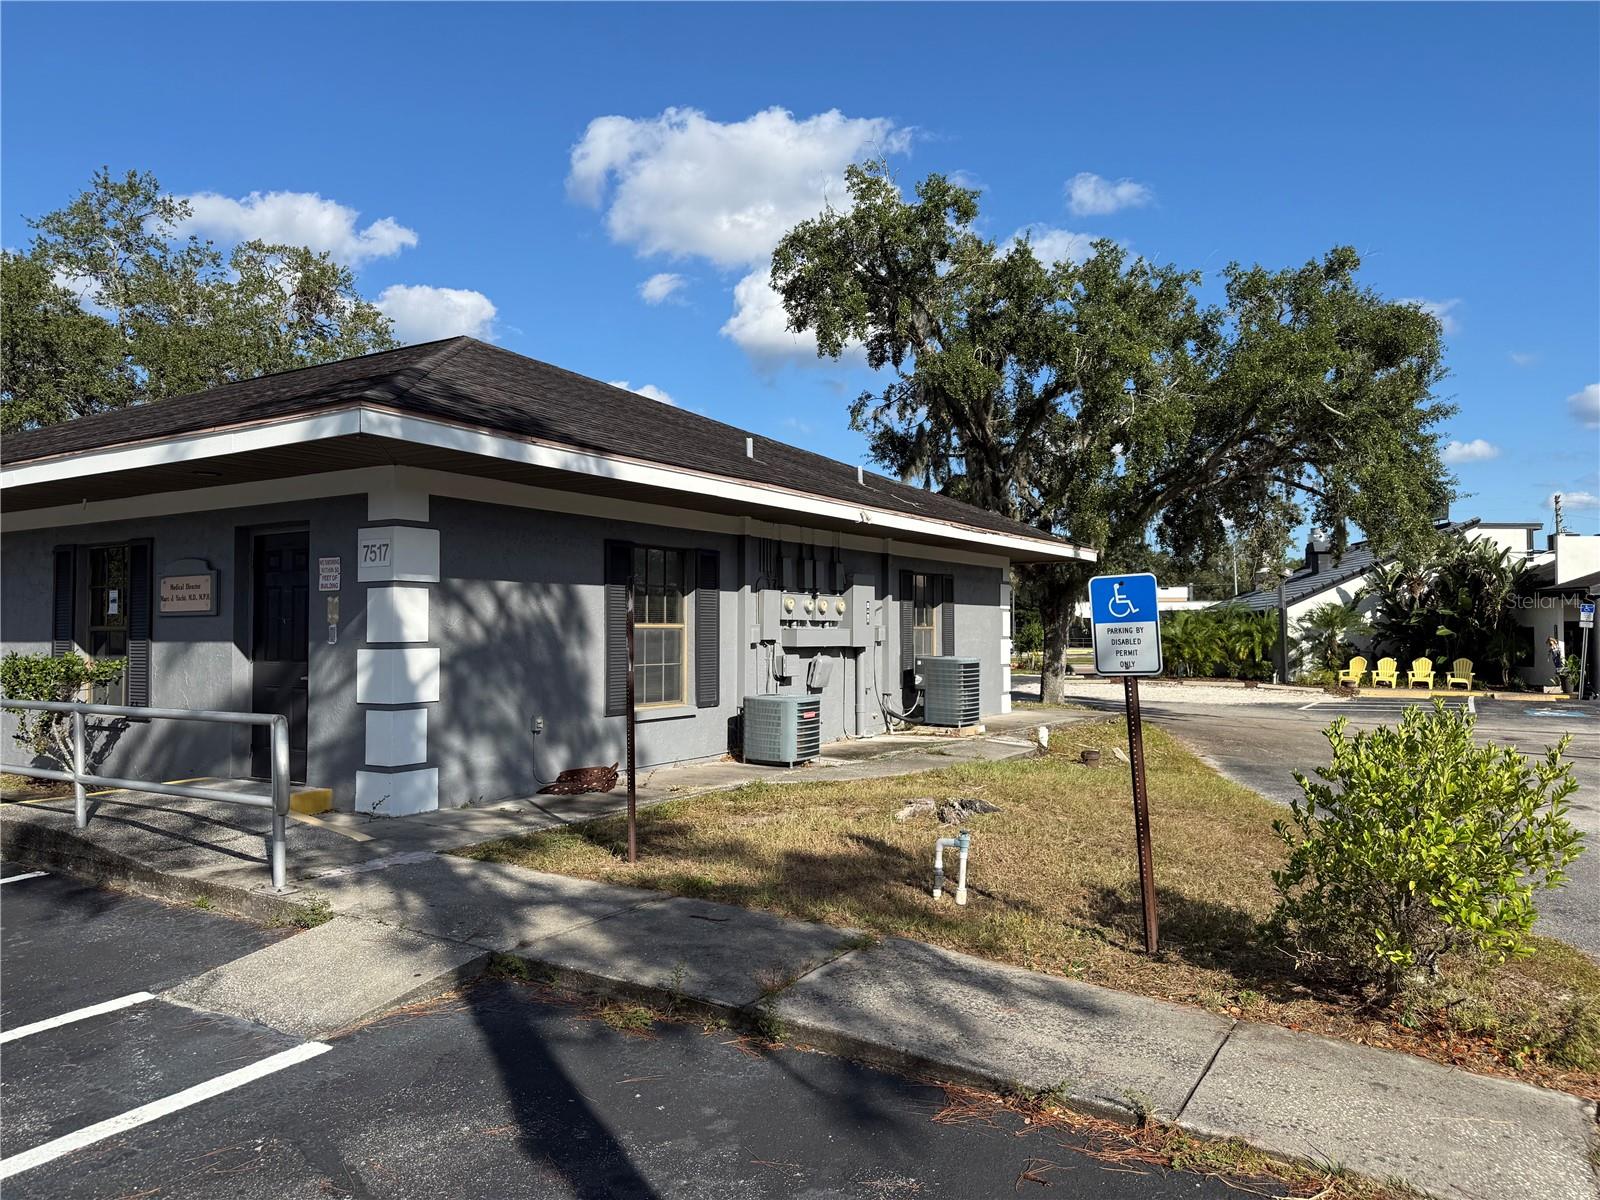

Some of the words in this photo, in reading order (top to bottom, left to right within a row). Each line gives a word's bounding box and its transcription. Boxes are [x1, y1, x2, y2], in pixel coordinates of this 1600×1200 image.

[362, 543, 389, 562] 7517
[1106, 627, 1133, 635] PARKING
[1136, 626, 1144, 634] BY
[1111, 638, 1142, 646] DISABLED
[1115, 649, 1138, 657] PERMIT
[1119, 660, 1136, 668] ONLY
